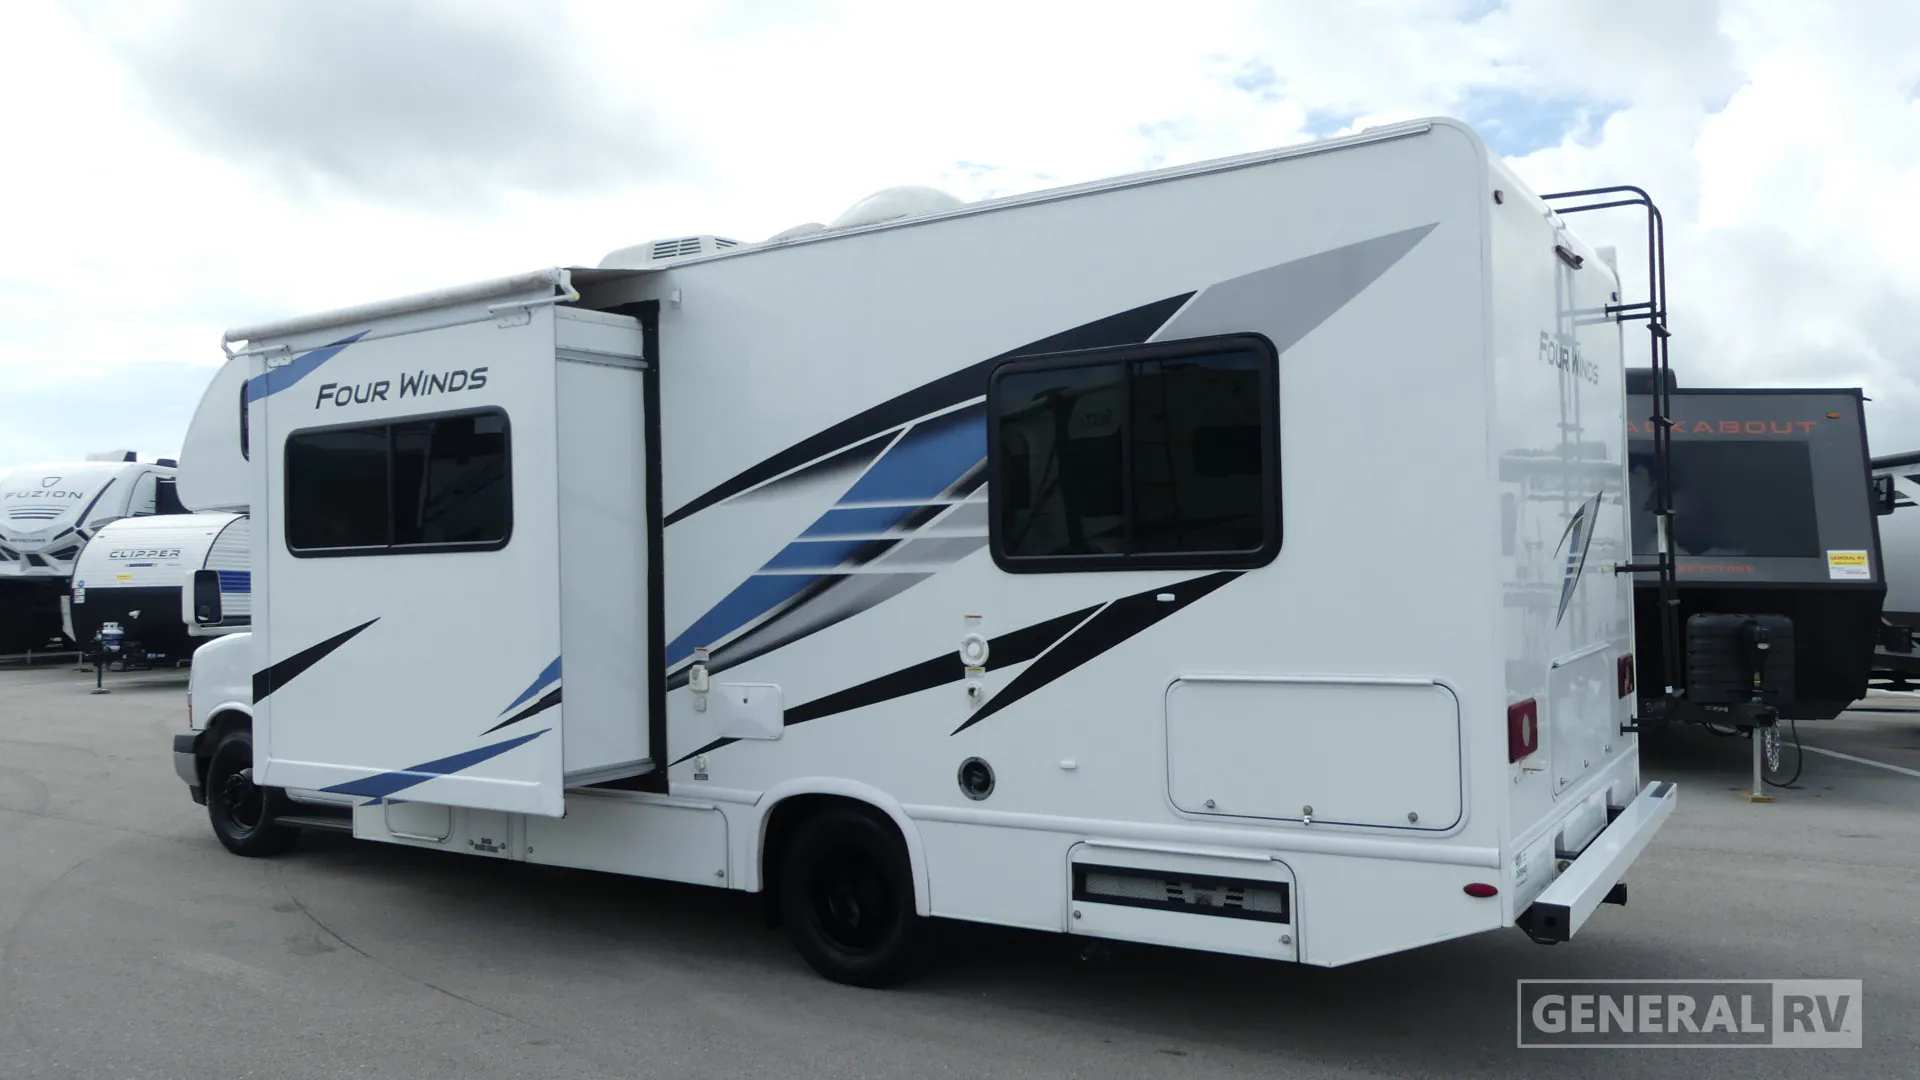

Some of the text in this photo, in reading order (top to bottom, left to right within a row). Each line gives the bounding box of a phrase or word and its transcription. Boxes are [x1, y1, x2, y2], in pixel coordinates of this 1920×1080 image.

[1539, 330, 1599, 386] FOUR WINDS
[315, 367, 489, 409] FOUR WINDS
[1627, 420, 1818, 434] ALKABOUT
[4, 490, 84, 500] FUZION
[109, 549, 181, 558] CLIPPER
